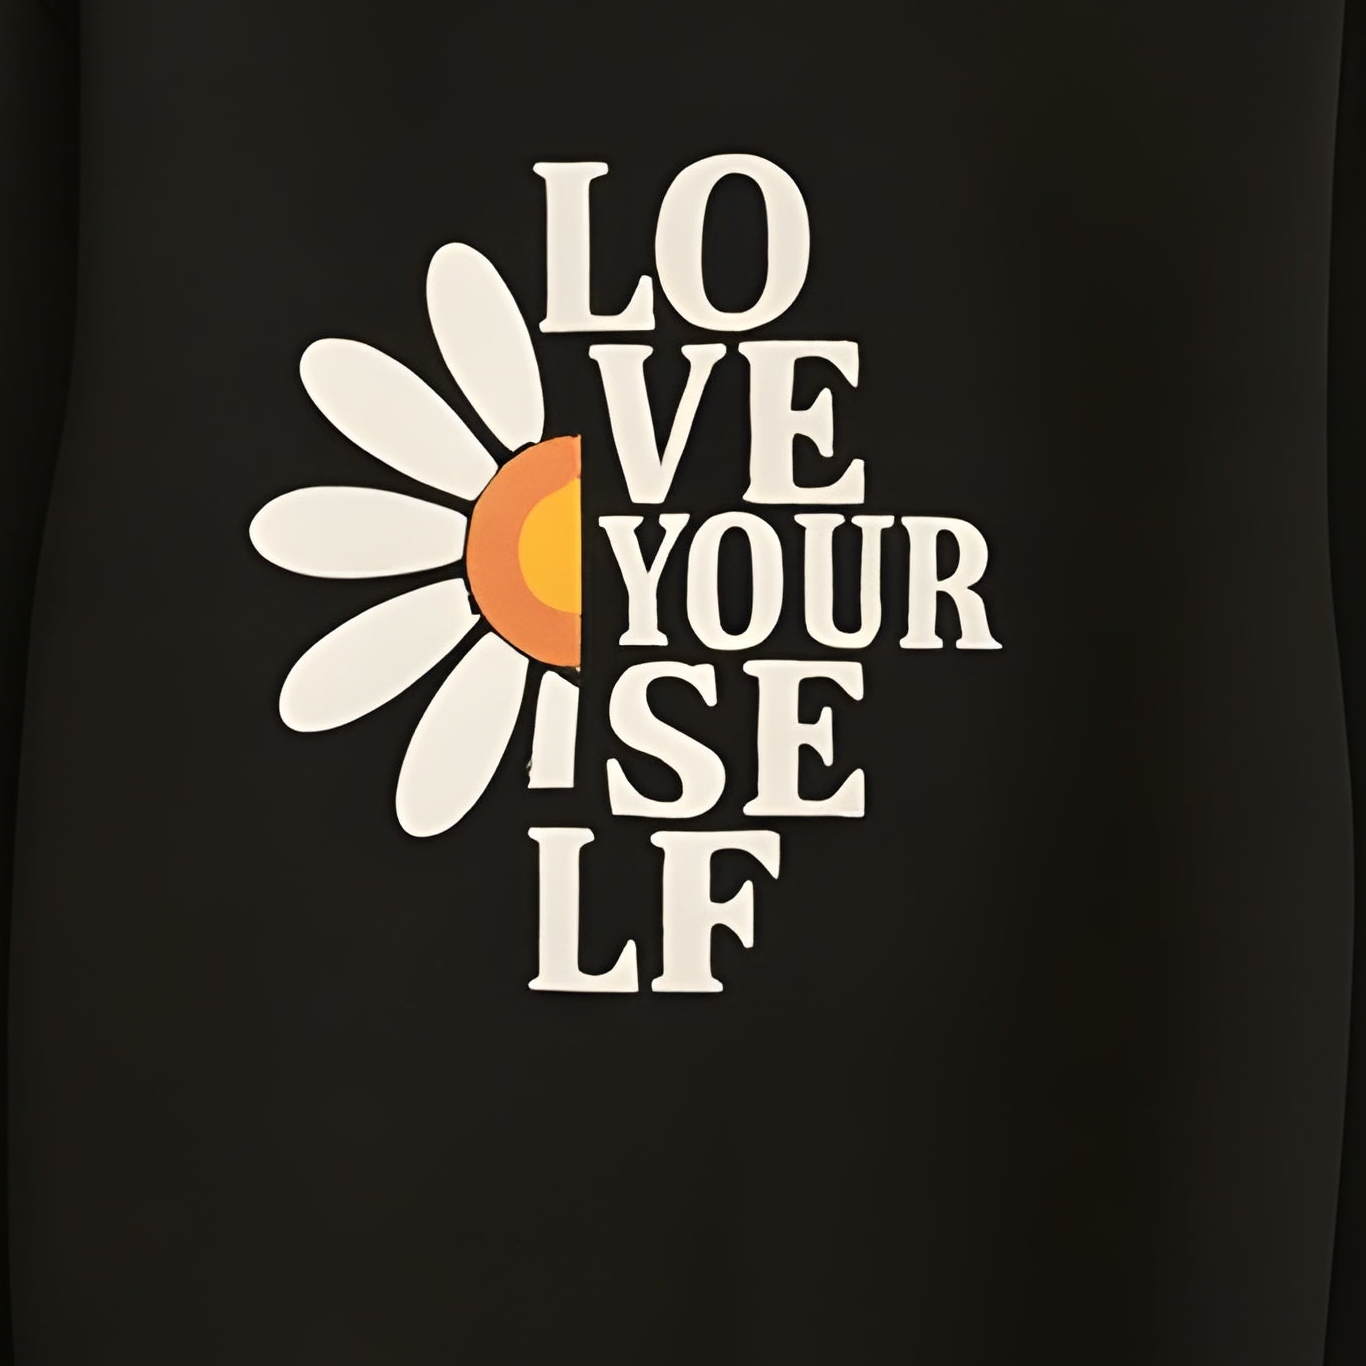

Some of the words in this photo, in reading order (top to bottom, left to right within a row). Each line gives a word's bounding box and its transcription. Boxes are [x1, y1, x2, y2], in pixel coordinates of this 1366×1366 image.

[533, 154, 810, 333] LO
[589, 341, 864, 505] VE
[598, 511, 1003, 650] YOUR
[606, 660, 865, 819] SE
[528, 827, 781, 993] LF
